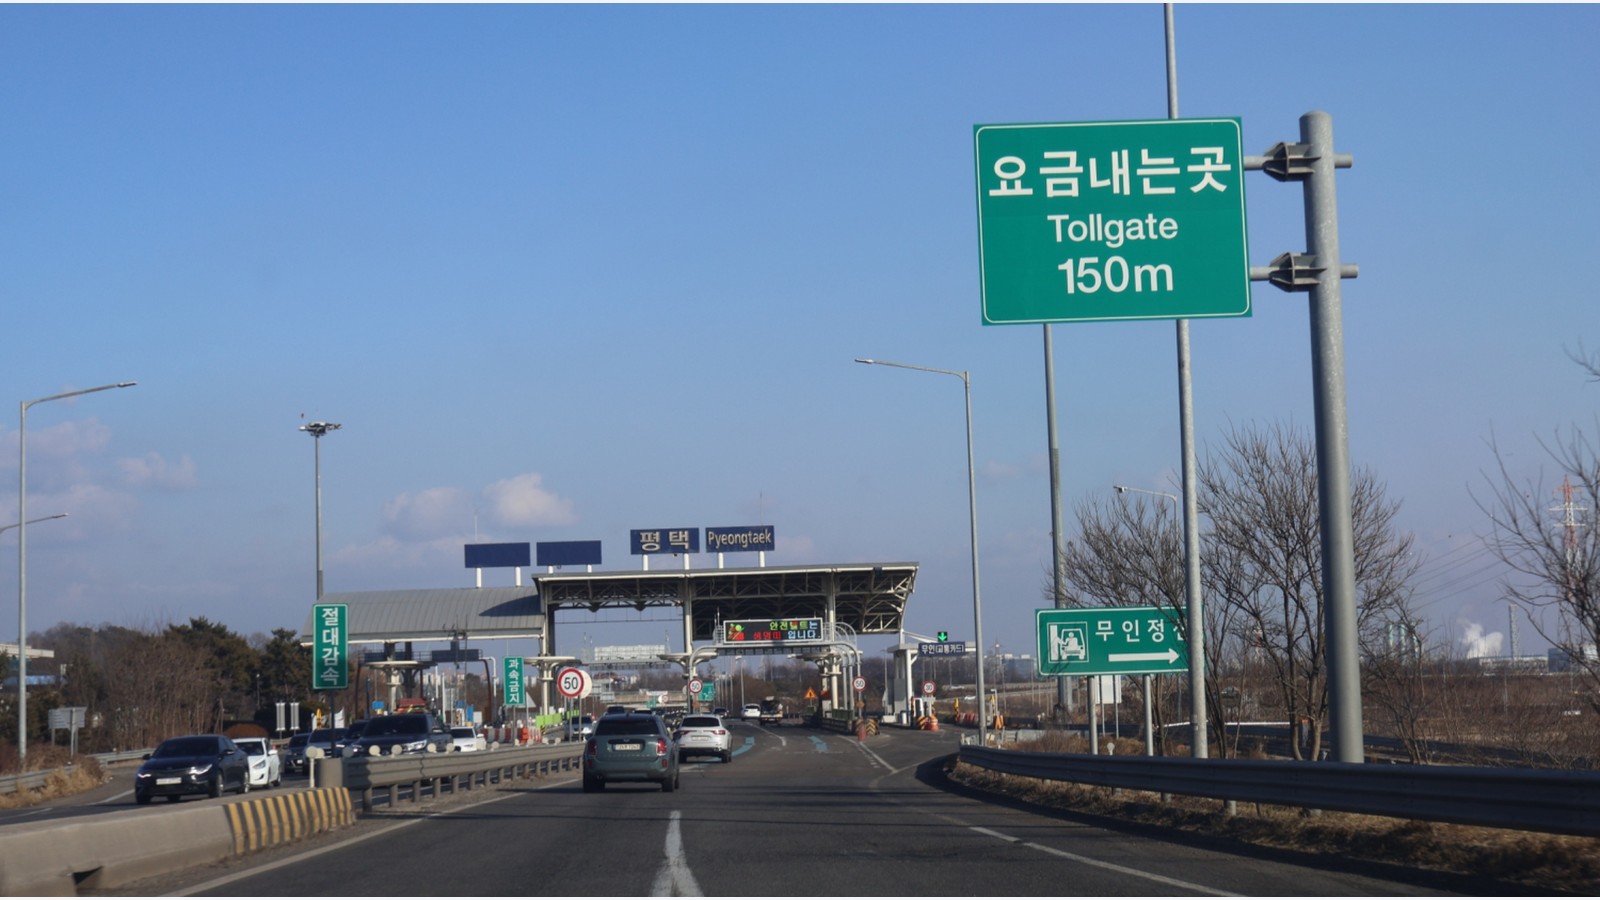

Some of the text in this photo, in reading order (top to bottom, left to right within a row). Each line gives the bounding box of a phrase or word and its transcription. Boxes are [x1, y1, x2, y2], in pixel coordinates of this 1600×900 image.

[988, 146, 1232, 198] 요금내는곳
[1047, 213, 1179, 248] Tollgate
[1058, 255, 1174, 294] 150m
[640, 530, 689, 551] 평택
[708, 529, 772, 549] Pyeongtaek
[320, 606, 340, 686] 절대감속
[508, 658, 520, 704] 과속금지
[564, 676, 579, 690] 50
[691, 682, 700, 691] 50
